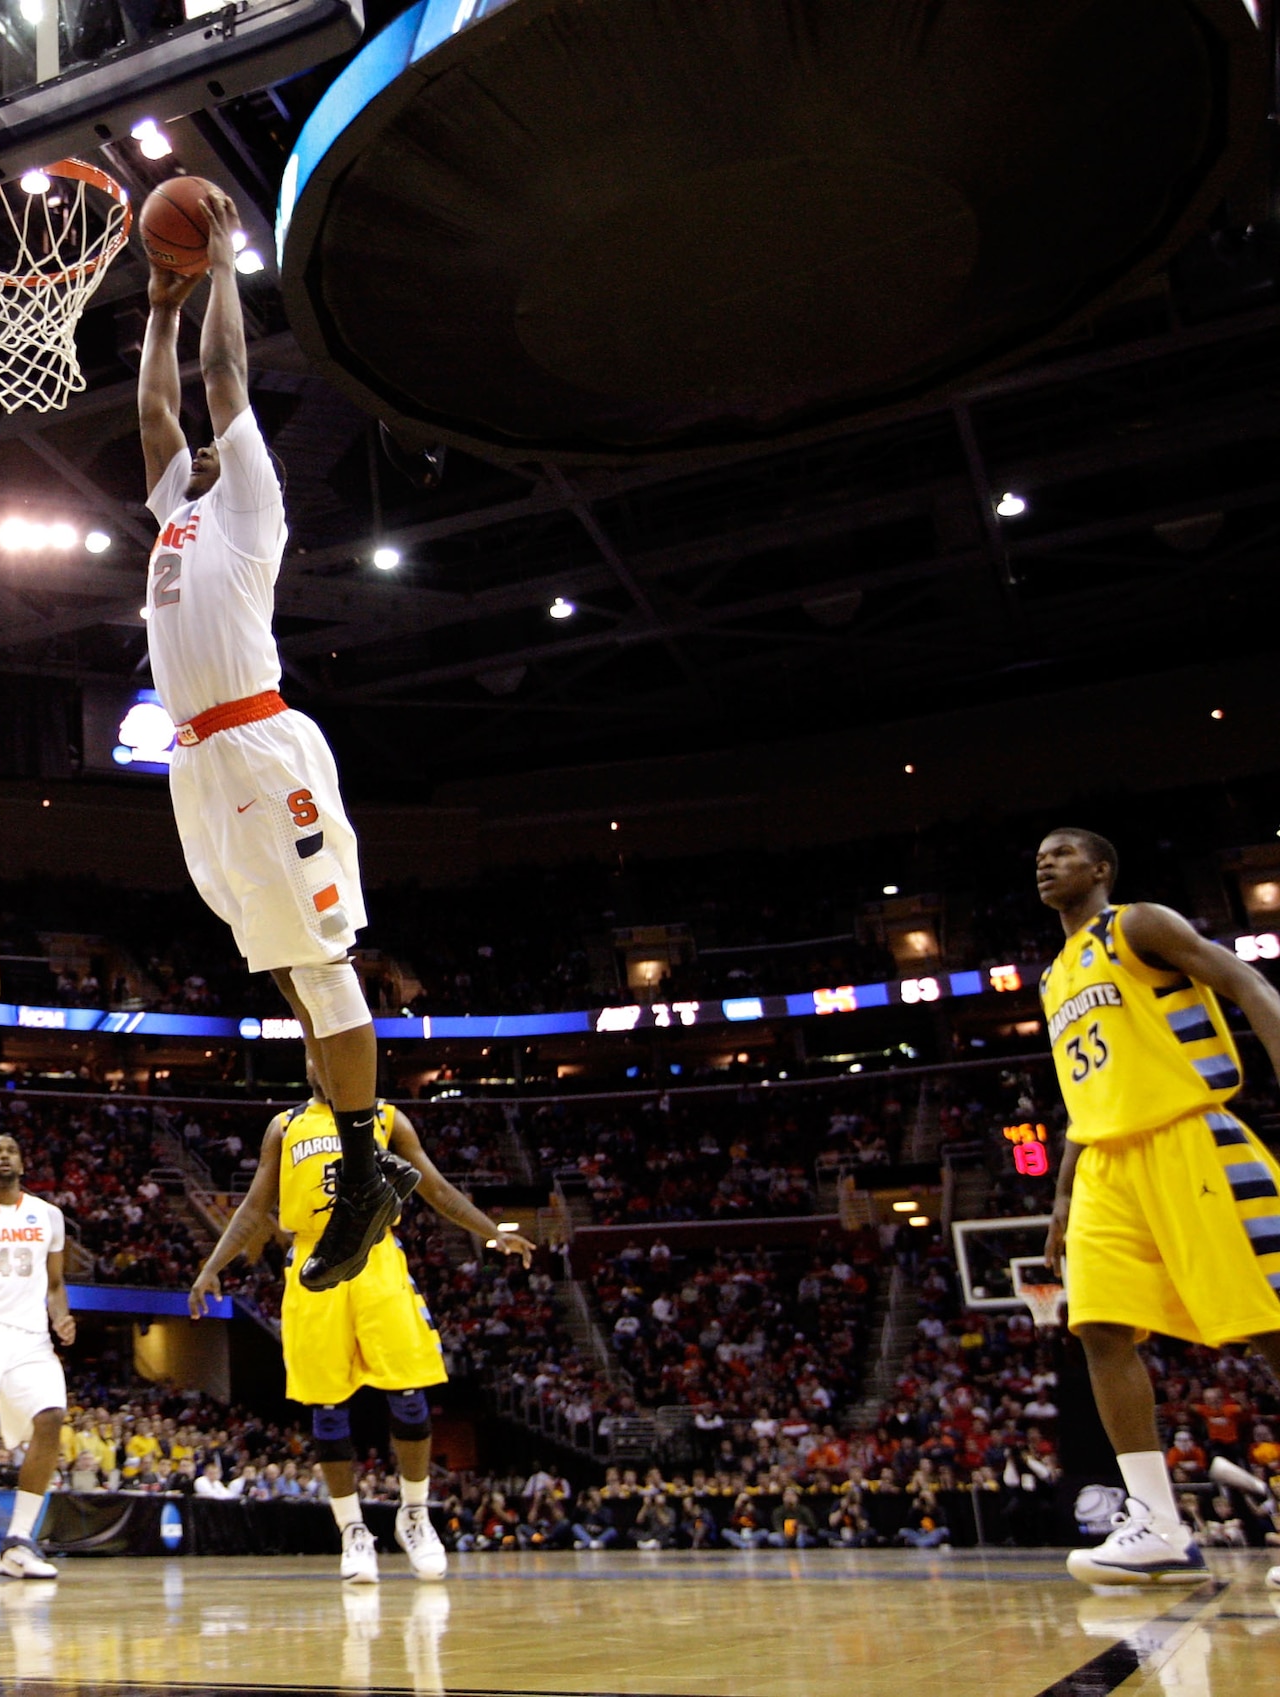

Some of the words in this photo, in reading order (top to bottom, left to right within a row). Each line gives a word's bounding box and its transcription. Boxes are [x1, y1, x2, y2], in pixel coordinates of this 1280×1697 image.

[286, 788, 319, 828] S
[1234, 933, 1280, 962] 53
[900, 977, 940, 1004] 53
[1065, 1022, 1108, 1083] 33
[291, 1134, 343, 1167] MARQU
[1013, 1141, 1049, 1177] 13
